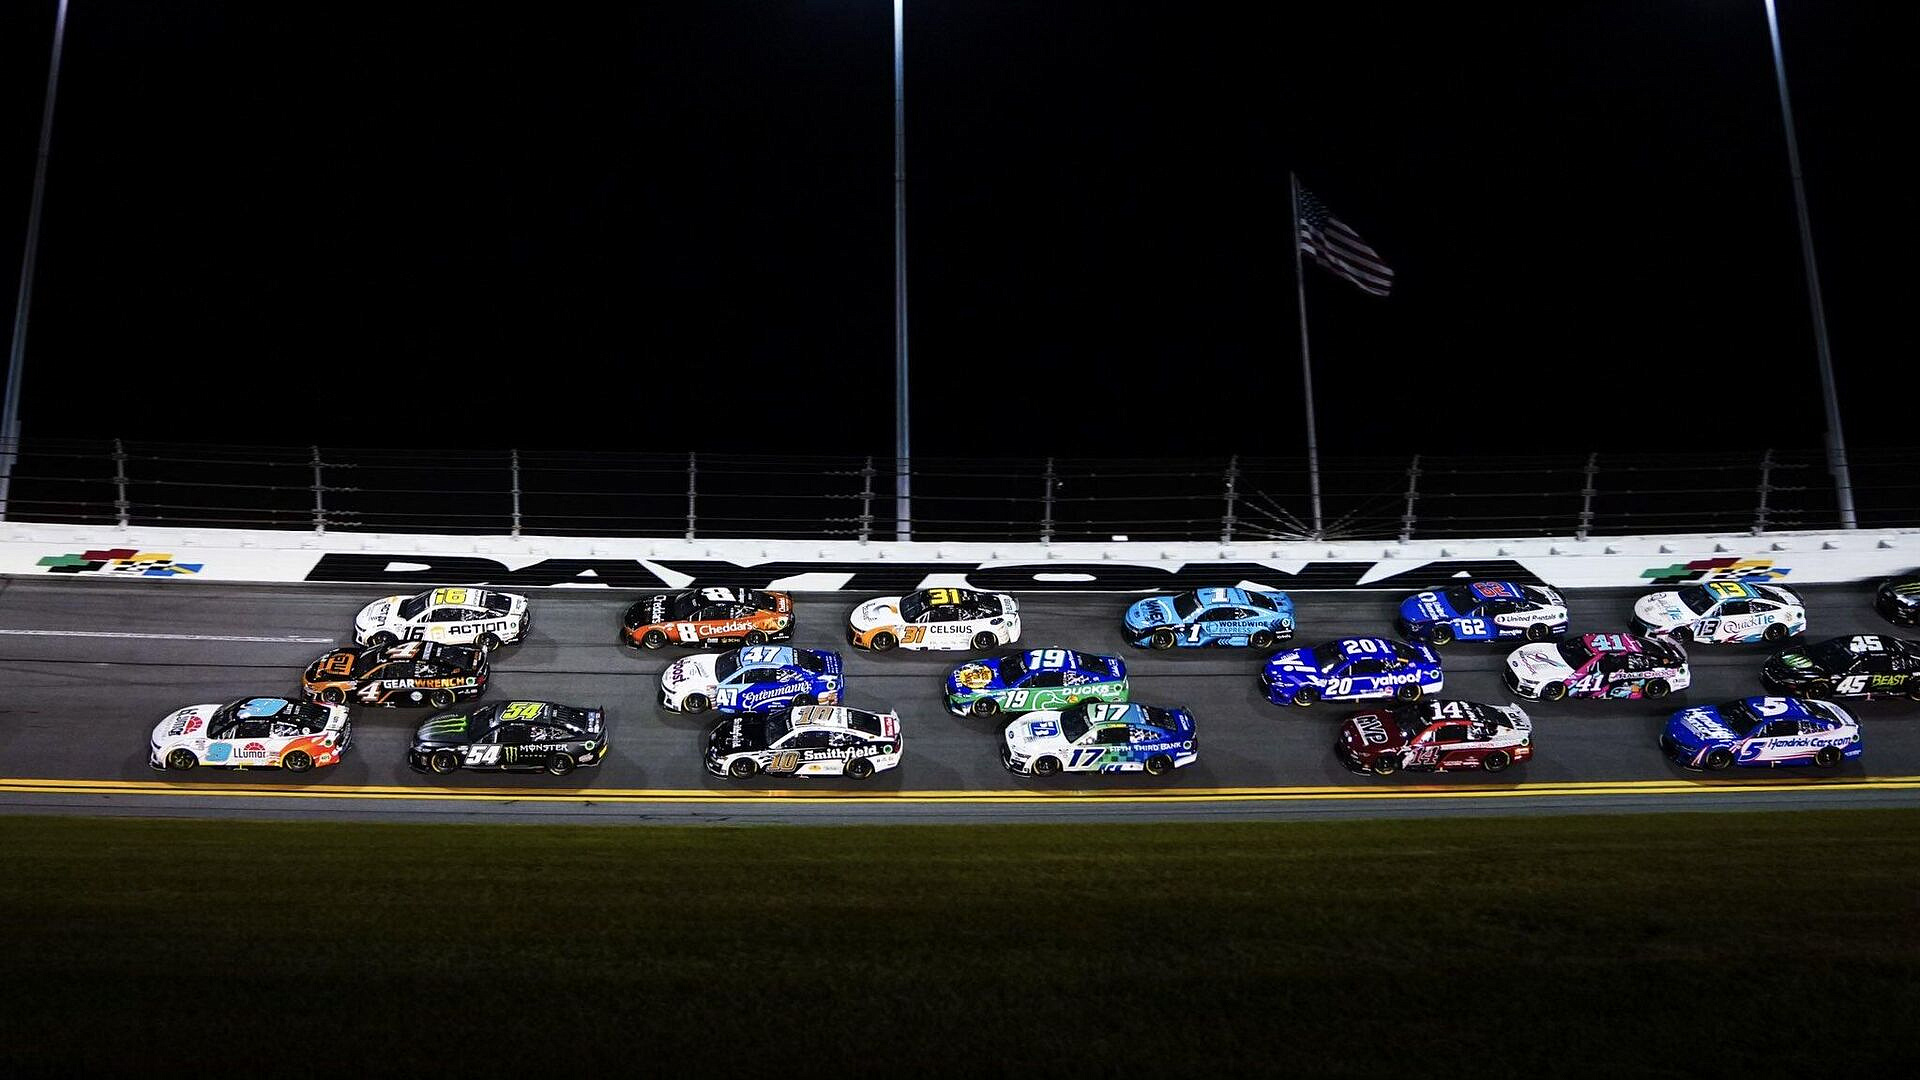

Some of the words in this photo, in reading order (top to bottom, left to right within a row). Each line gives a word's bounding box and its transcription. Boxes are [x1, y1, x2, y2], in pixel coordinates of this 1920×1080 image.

[305, 553, 1553, 590] DAYTONA
[434, 588, 468, 605] 16
[930, 588, 960, 605] 31
[1211, 588, 1230, 603] 1
[1473, 581, 1513, 598] 62
[1710, 583, 1747, 597] 13
[449, 621, 508, 635] ACTION
[699, 621, 753, 637] Cheddar's
[930, 625, 973, 634] CELSIUS
[1461, 619, 1486, 635] 62
[1699, 619, 1720, 637] 13
[1724, 614, 1775, 633] QuickTie
[402, 626, 426, 641] 16
[677, 623, 700, 642] 8
[900, 625, 927, 643] 31
[1187, 624, 1201, 642] 1
[386, 642, 422, 660] 4
[1343, 639, 1378, 654] 20
[1592, 635, 1626, 651] 41
[743, 647, 781, 662] 47
[1029, 649, 1067, 670] 19
[383, 677, 465, 689] GEARWRENCH
[1325, 678, 1352, 695] 20
[1370, 669, 1421, 688] yahoo!
[1576, 675, 1604, 692] 41
[1836, 676, 1869, 693] 45
[1872, 675, 1906, 687] BEAST
[357, 682, 382, 701] 4
[716, 688, 738, 707] 47
[742, 680, 812, 709] Entenmann's
[1004, 690, 1030, 708] 19
[500, 702, 547, 721] 54
[796, 706, 834, 725] 10
[1094, 704, 1129, 722] 17
[1430, 701, 1463, 720] 14
[233, 748, 267, 759] LLumar
[464, 744, 503, 765] 54
[520, 744, 568, 753] MONSTER
[804, 745, 878, 762] Smithfield
[1134, 744, 1158, 752] THIRD
[1160, 742, 1182, 750] BANK
[767, 752, 800, 772] 10
[1068, 748, 1106, 768] 17
[1410, 746, 1440, 766] 14
